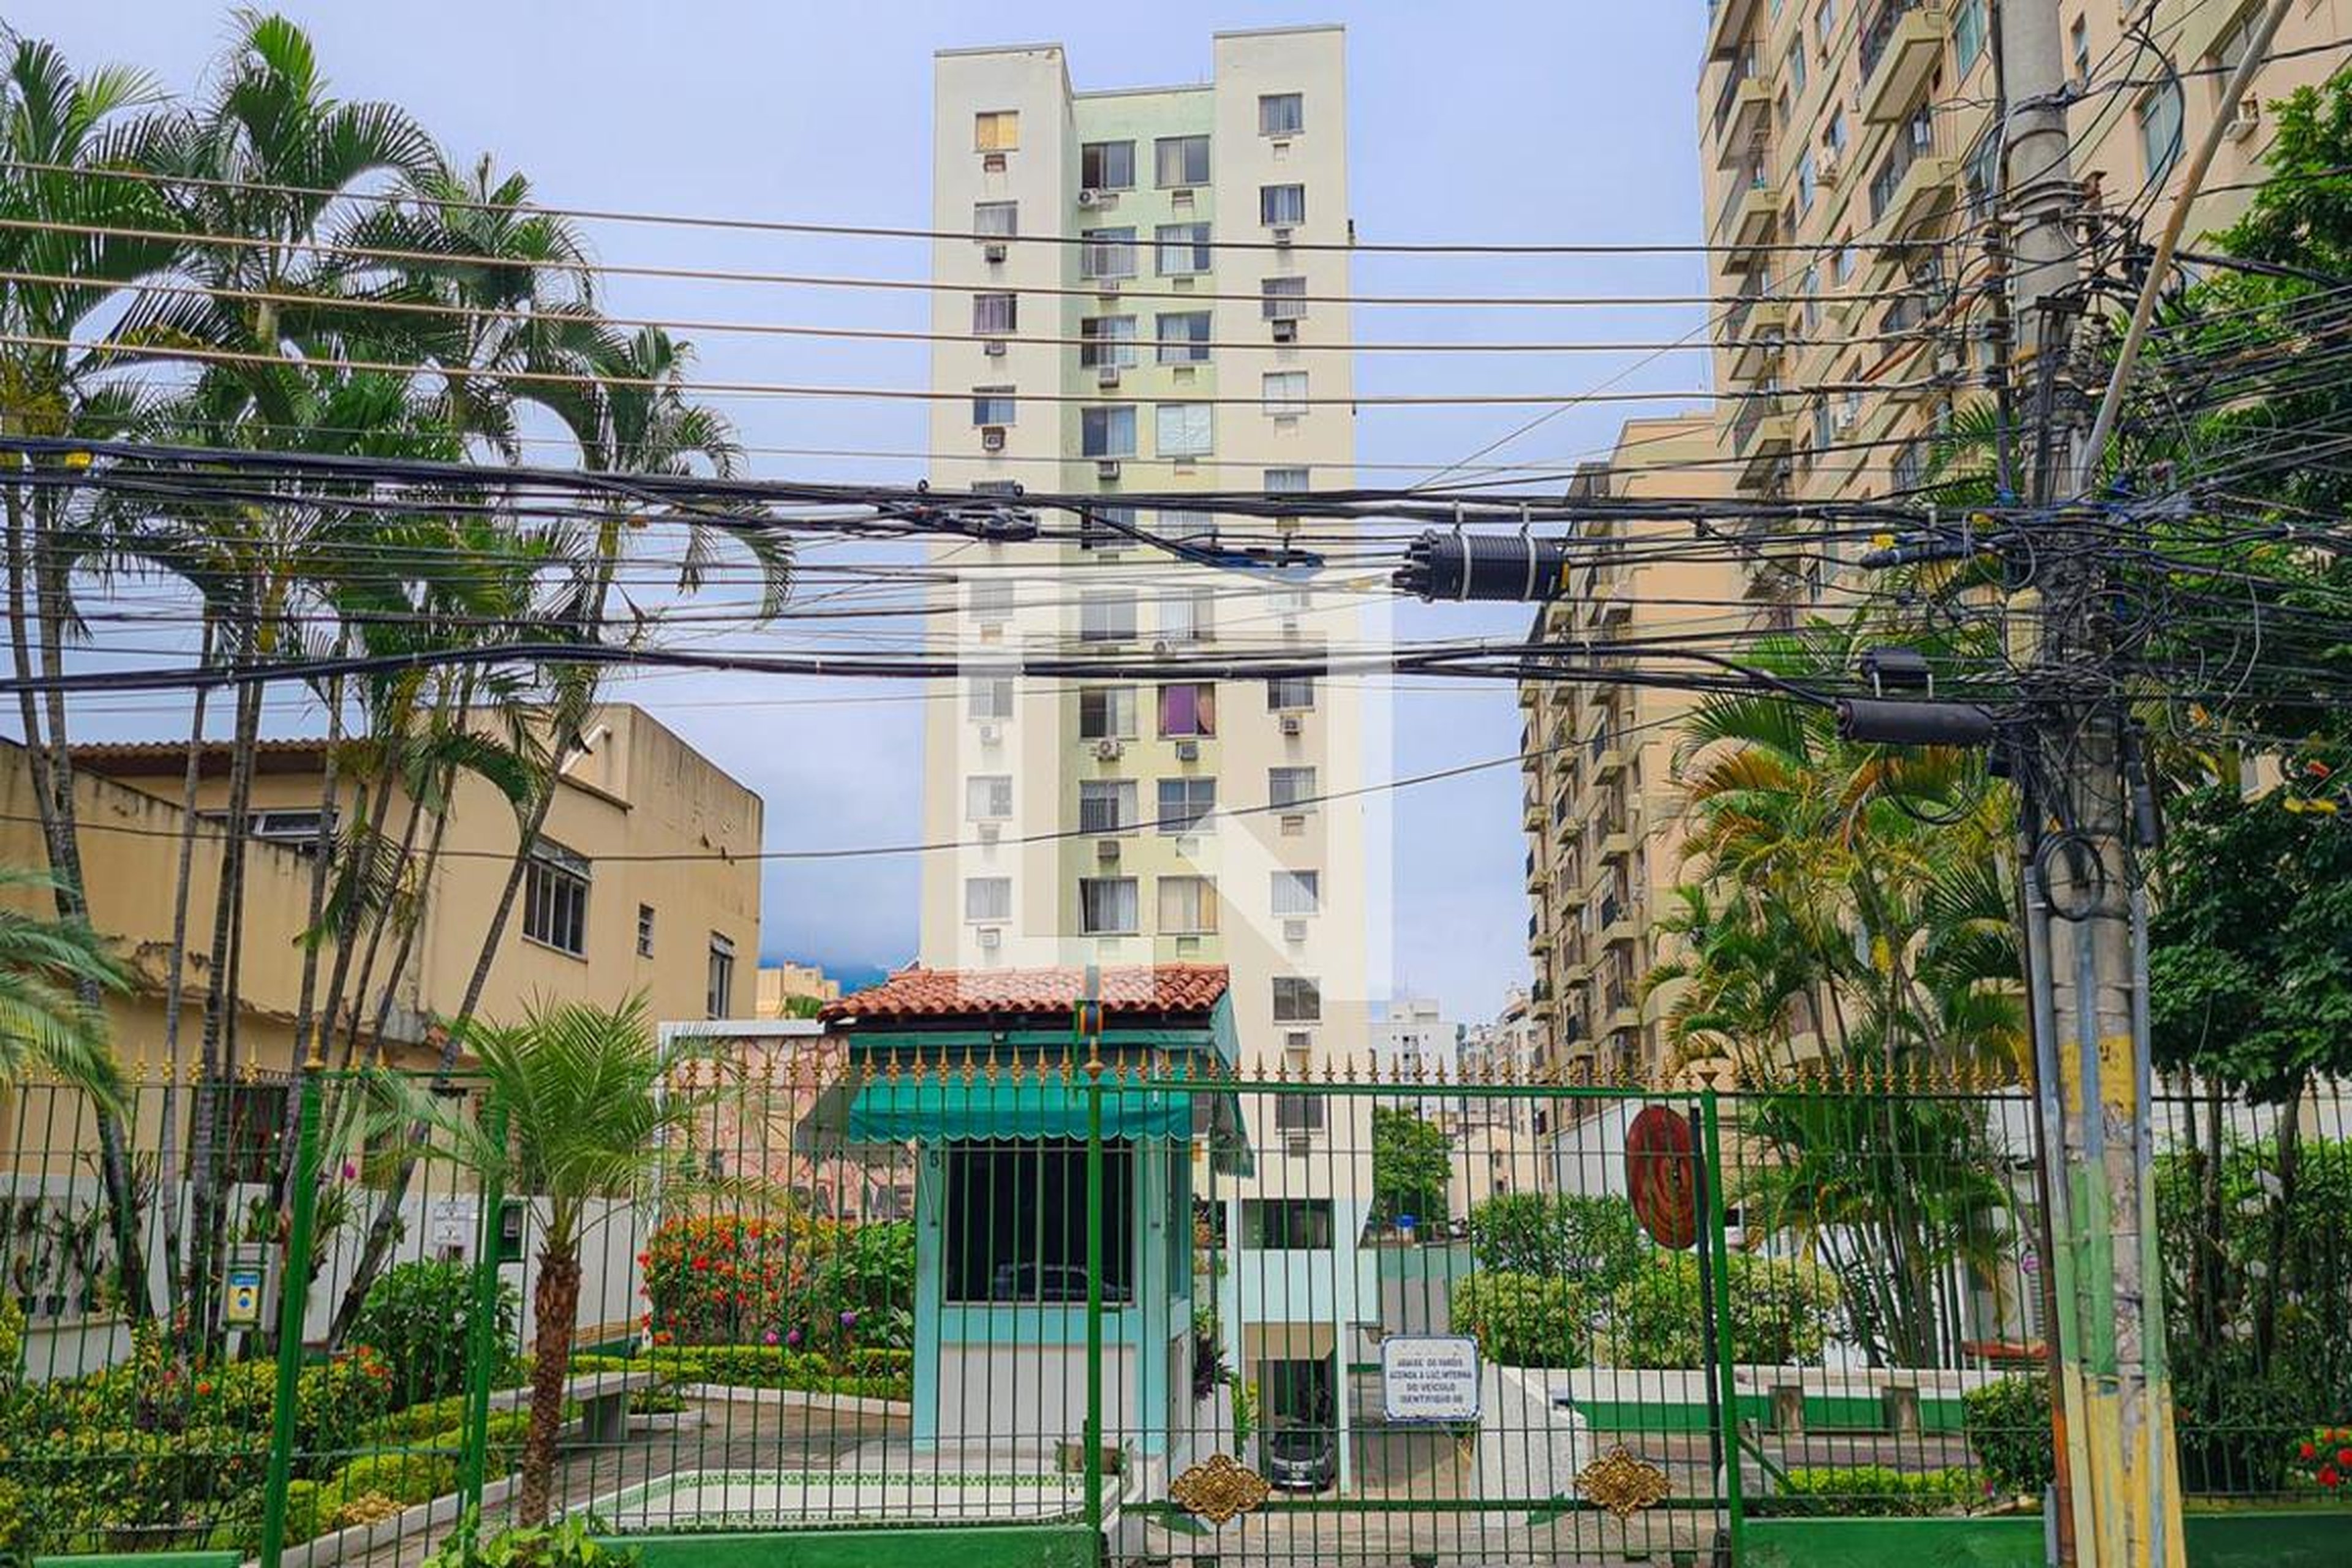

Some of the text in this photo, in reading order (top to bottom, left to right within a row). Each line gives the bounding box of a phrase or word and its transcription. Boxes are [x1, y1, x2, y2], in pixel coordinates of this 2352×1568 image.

[1389, 1370, 1472, 1379] ACENDA A LUZ INTERNA
[1406, 1382, 1419, 1392] DO
